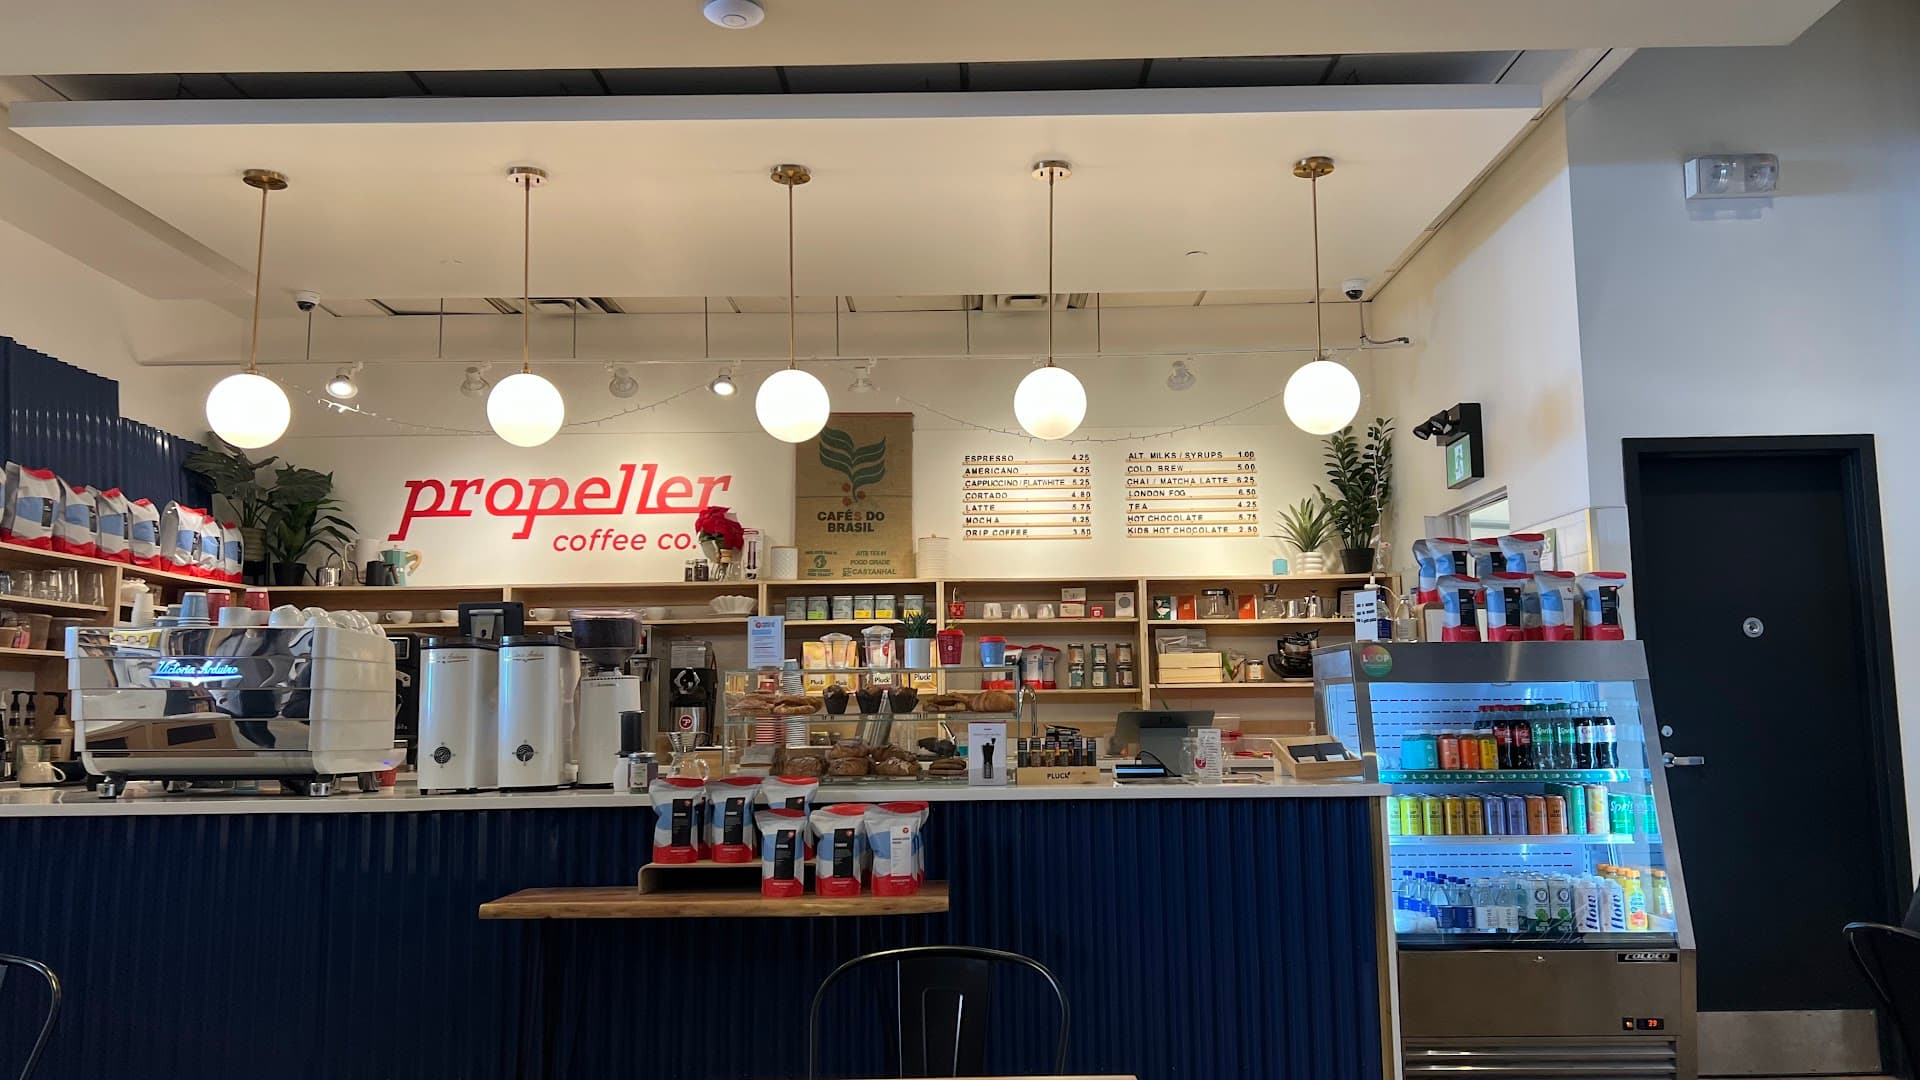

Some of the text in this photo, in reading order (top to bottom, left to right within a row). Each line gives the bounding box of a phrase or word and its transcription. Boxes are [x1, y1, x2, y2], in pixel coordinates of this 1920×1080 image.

[1184, 451, 1223, 459] SYRUPS
[965, 467, 1019, 475] AMERICANO
[1127, 465, 1152, 473] COLD
[1169, 489, 1186, 497] FOG
[388, 463, 732, 542] propeller
[965, 504, 995, 512] LATTE
[817, 509, 885, 521] CAFÉS DO
[1147, 514, 1203, 522] CHOCOLATE
[827, 522, 875, 533] BRASIL
[1173, 526, 1228, 534] CHOCOLATE
[965, 529, 989, 537] DRIP
[553, 529, 698, 552] coffee co.
[156, 659, 239, 674] Victoria Arduino
[1586, 894, 1599, 930] flow
[1610, 893, 1625, 930] flow
